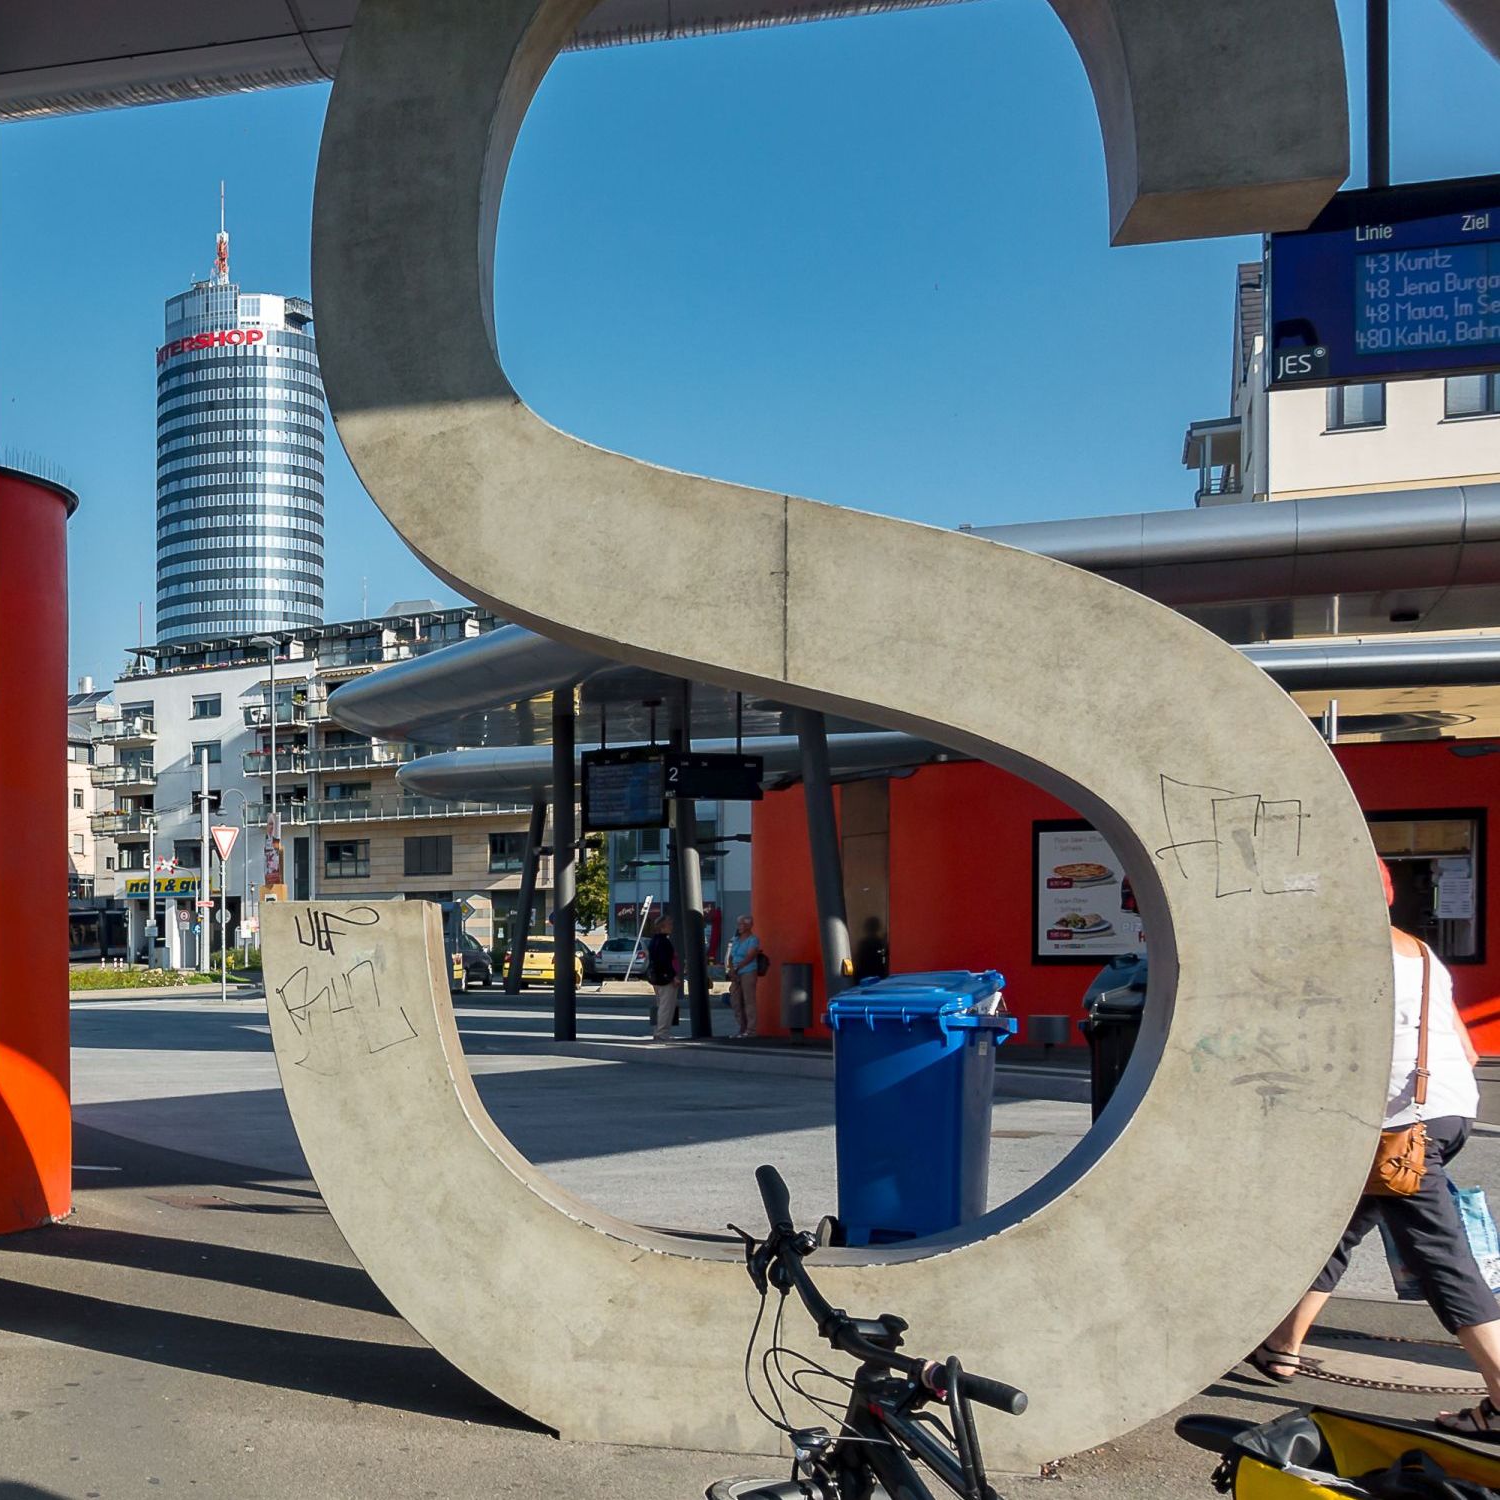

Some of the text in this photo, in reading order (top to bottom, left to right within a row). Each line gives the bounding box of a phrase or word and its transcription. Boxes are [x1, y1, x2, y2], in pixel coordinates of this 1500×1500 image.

[1356, 213, 1489, 241] Linie Ziel
[1365, 249, 1452, 274] 43 Kunitz
[1365, 278, 1390, 299] 48
[1395, 276, 1440, 297] Jena
[1365, 303, 1390, 324] 48
[1355, 327, 1391, 350] 480
[1277, 354, 1311, 379] JES
[669, 767, 679, 782] 2
[164, 879, 176, 891] &
[180, 880, 210, 893] gu
